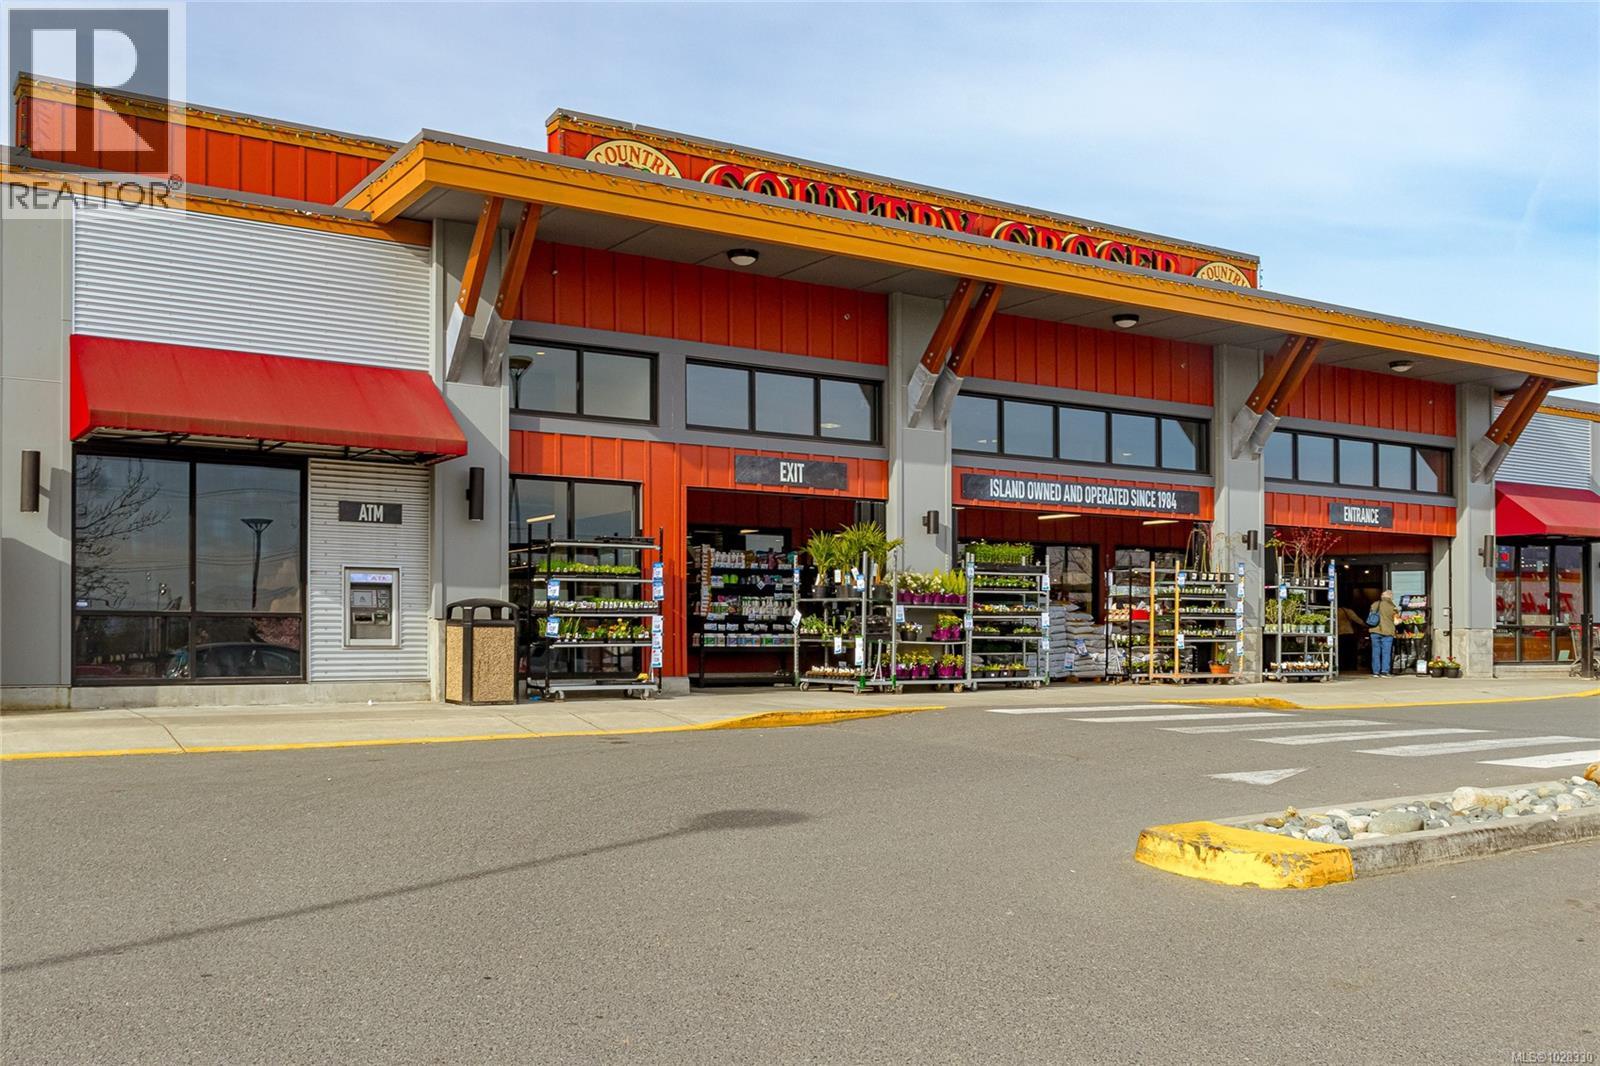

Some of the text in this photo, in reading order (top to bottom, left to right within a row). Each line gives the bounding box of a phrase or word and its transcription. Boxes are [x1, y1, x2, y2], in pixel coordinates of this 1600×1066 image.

[780, 462, 804, 483] EXIT
[990, 478, 1177, 510] ISLAND OWNED AND OPERATED SINCE 1984
[358, 504, 384, 522] ATM
[1343, 506, 1380, 524] ENTRANCE
